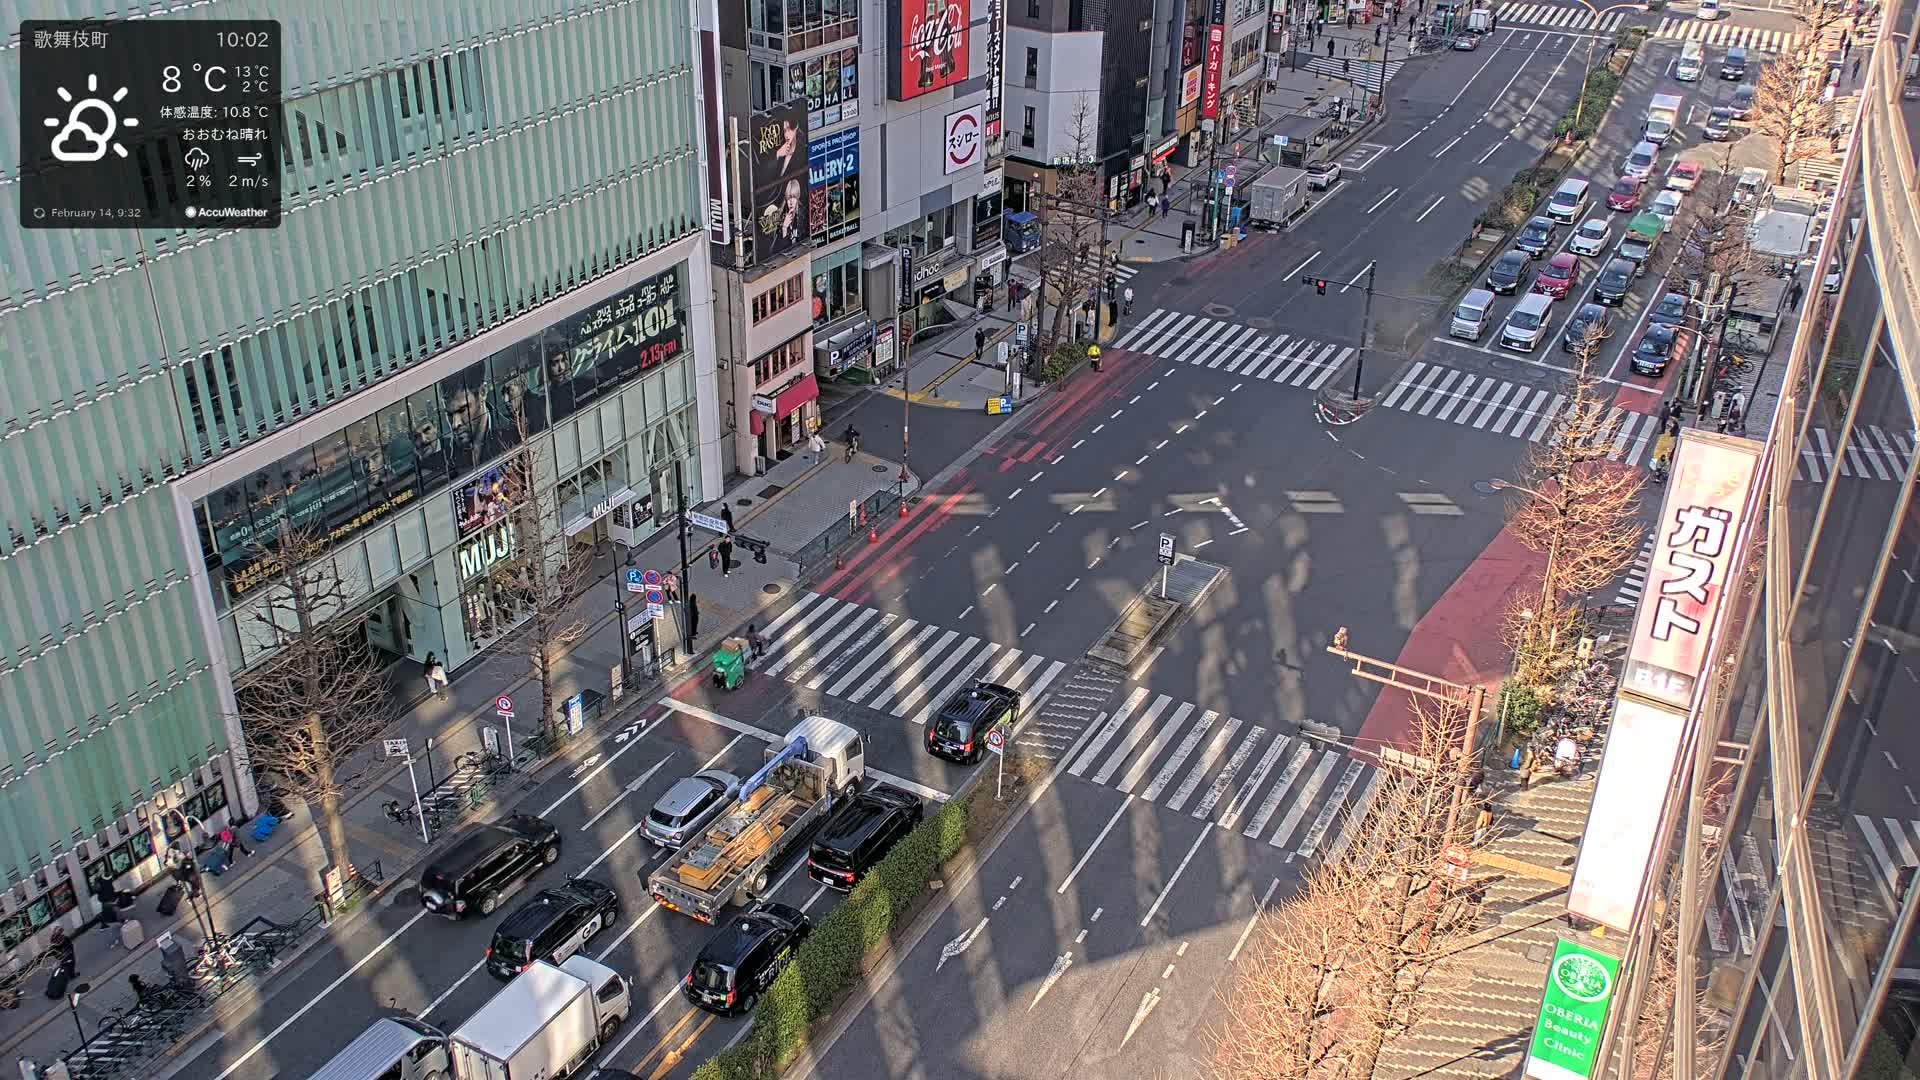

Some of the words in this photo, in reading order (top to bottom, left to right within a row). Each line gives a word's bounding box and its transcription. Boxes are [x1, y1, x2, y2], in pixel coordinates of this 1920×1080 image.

[909, 4, 962, 62] Coca-Cola
[1206, 45, 1220, 109] バーガーキング
[808, 98, 821, 111] OD
[825, 87, 853, 105] HALL
[811, 140, 831, 152] SPORTS
[949, 131, 979, 150] スシロー
[809, 154, 854, 184] ALLERY-2
[710, 198, 723, 232] MUJI
[830, 223, 858, 239] BASKETBALL
[903, 248, 910, 257] P
[615, 303, 635, 318] ラファロ
[619, 294, 634, 307] マーク
[596, 305, 611, 319] クリス
[1019, 325, 1026, 334] P
[641, 343, 660, 368] 2.13
[663, 338, 677, 355] FRI
[831, 351, 840, 365] P
[1000, 398, 1007, 408] P
[593, 496, 615, 519] MUJI
[460, 522, 517, 580] MUJI
[1161, 538, 1169, 547] P
[630, 572, 636, 581] P
[1651, 506, 1732, 640] ガスト
[1544, 1003, 1599, 1030] OBERIA
[1543, 1019, 1592, 1045] Beauty
[1543, 1037, 1585, 1060] Clinic
